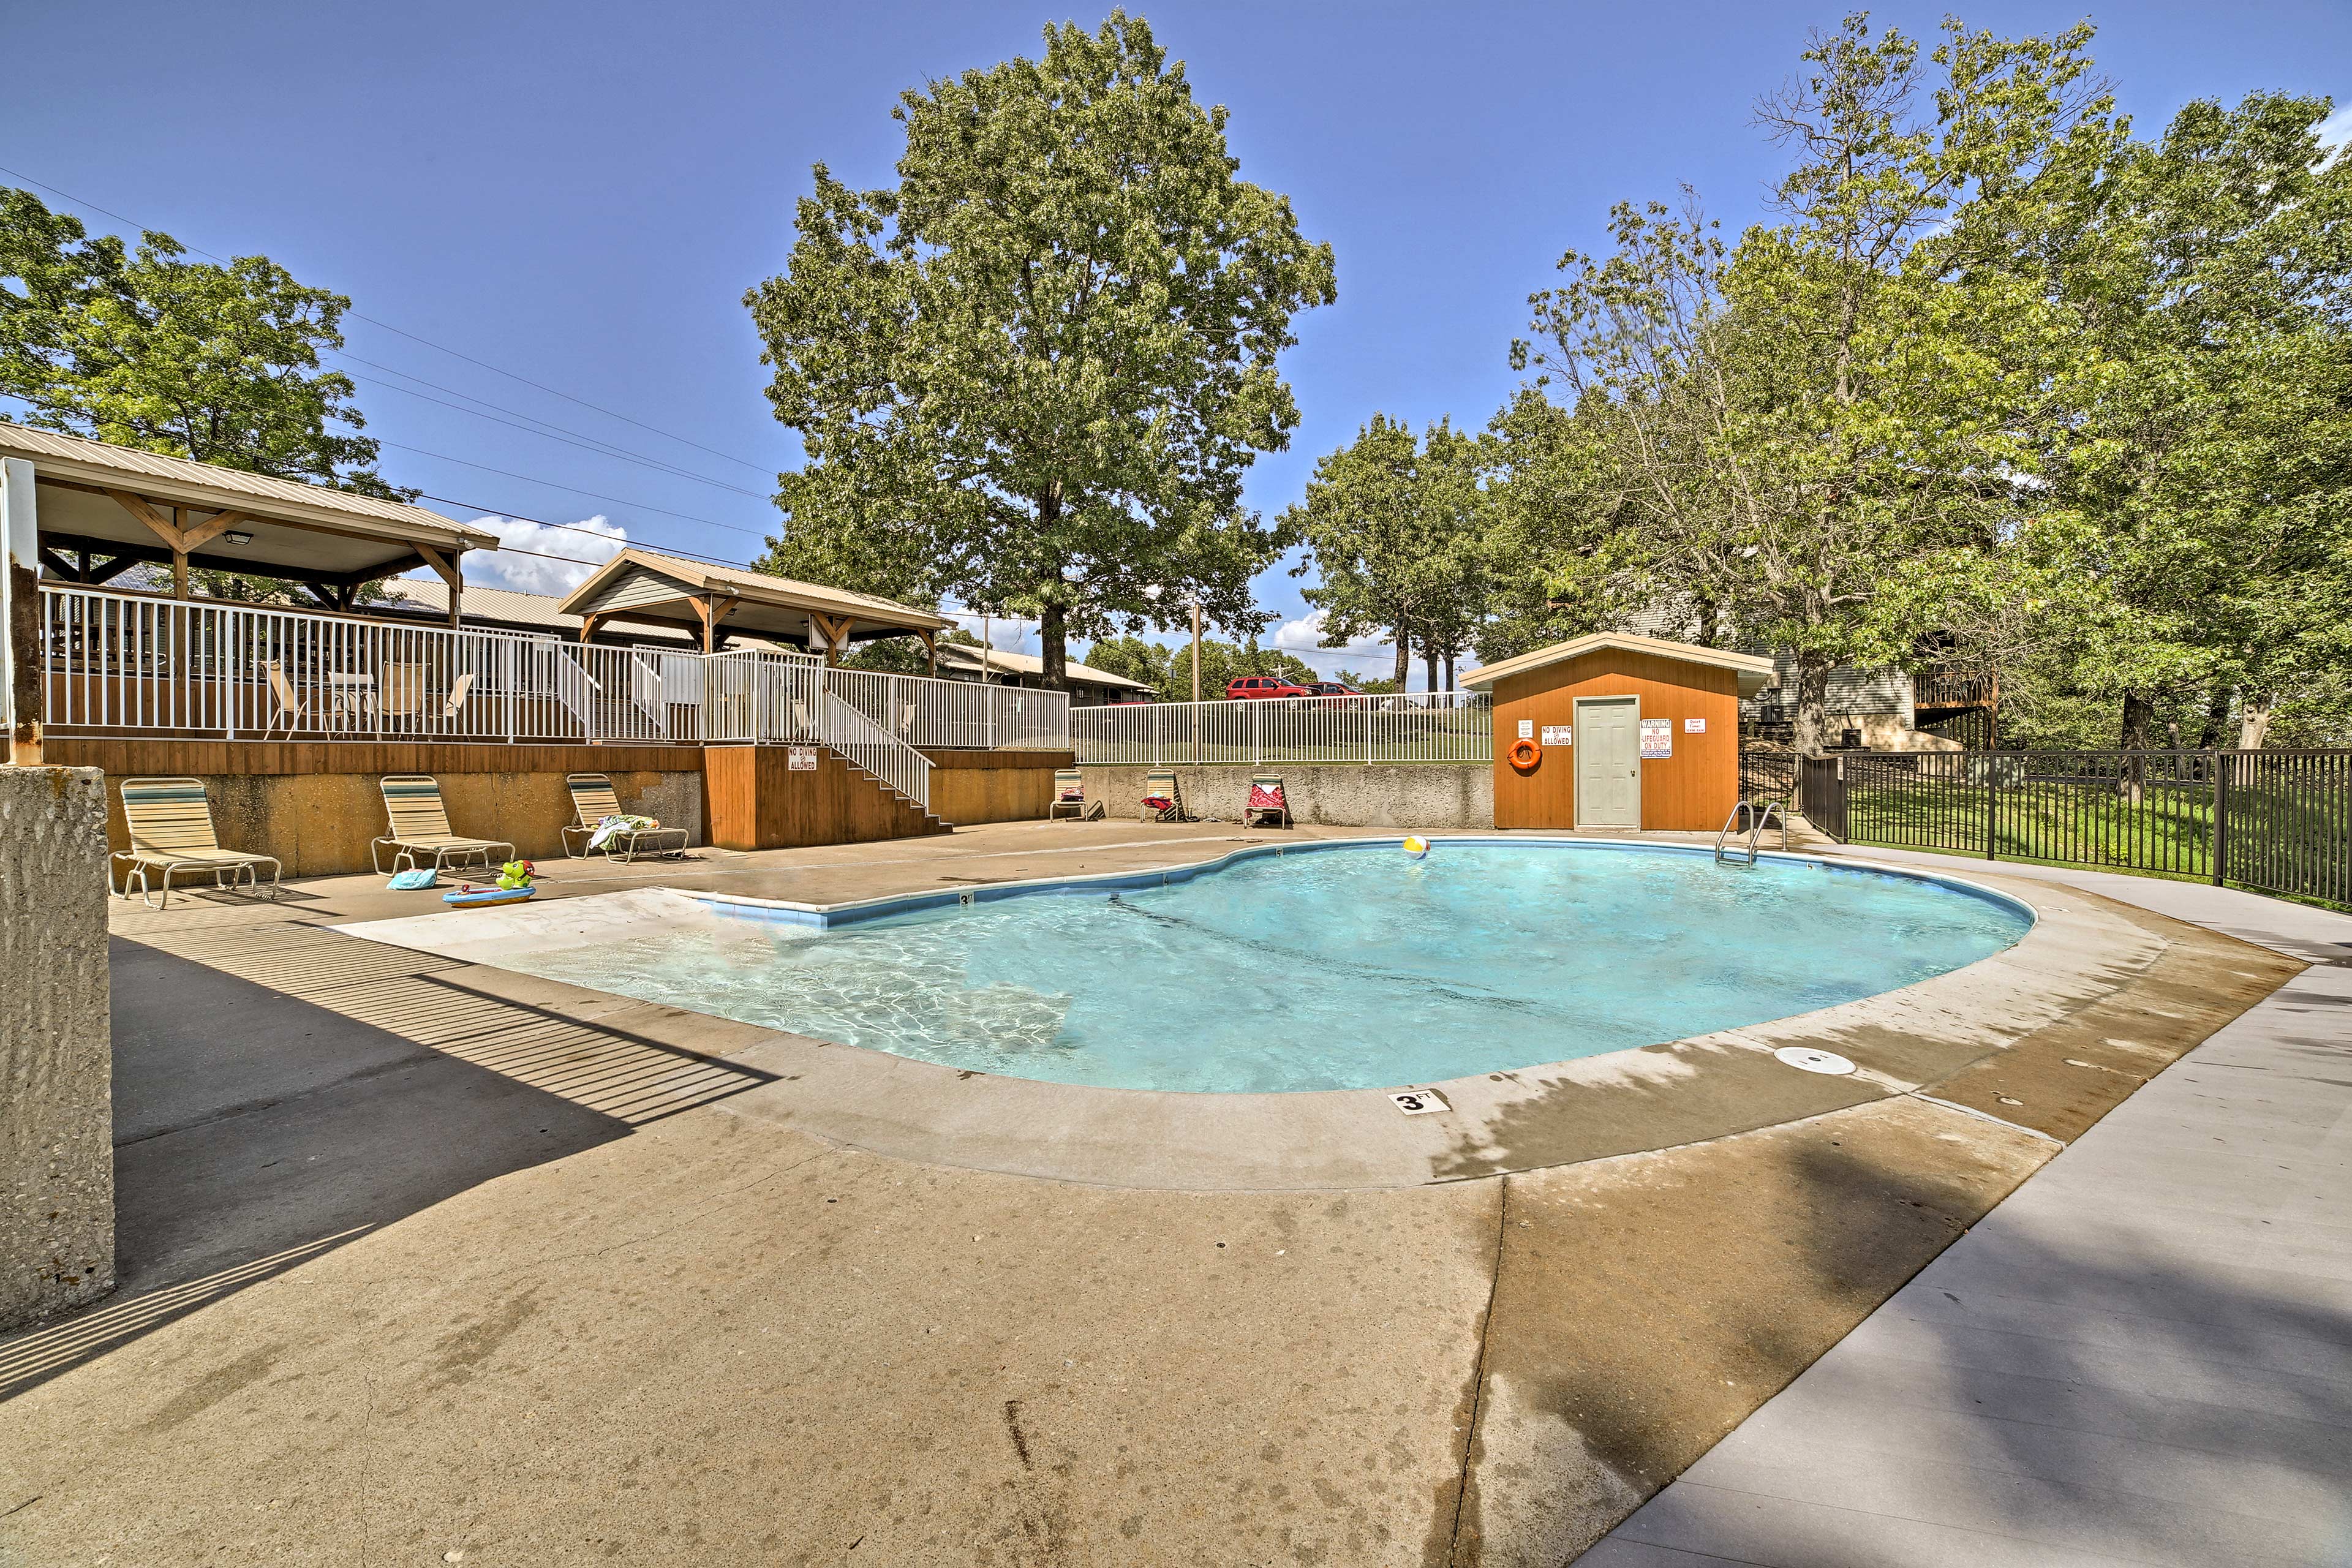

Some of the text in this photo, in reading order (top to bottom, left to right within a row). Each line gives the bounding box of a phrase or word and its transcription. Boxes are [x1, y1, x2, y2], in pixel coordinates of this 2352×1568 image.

[799, 748, 816, 756] DIVING
[791, 761, 815, 770] ALLOWED
[961, 895, 968, 905] 3
[1396, 1096, 1424, 1110] 3
